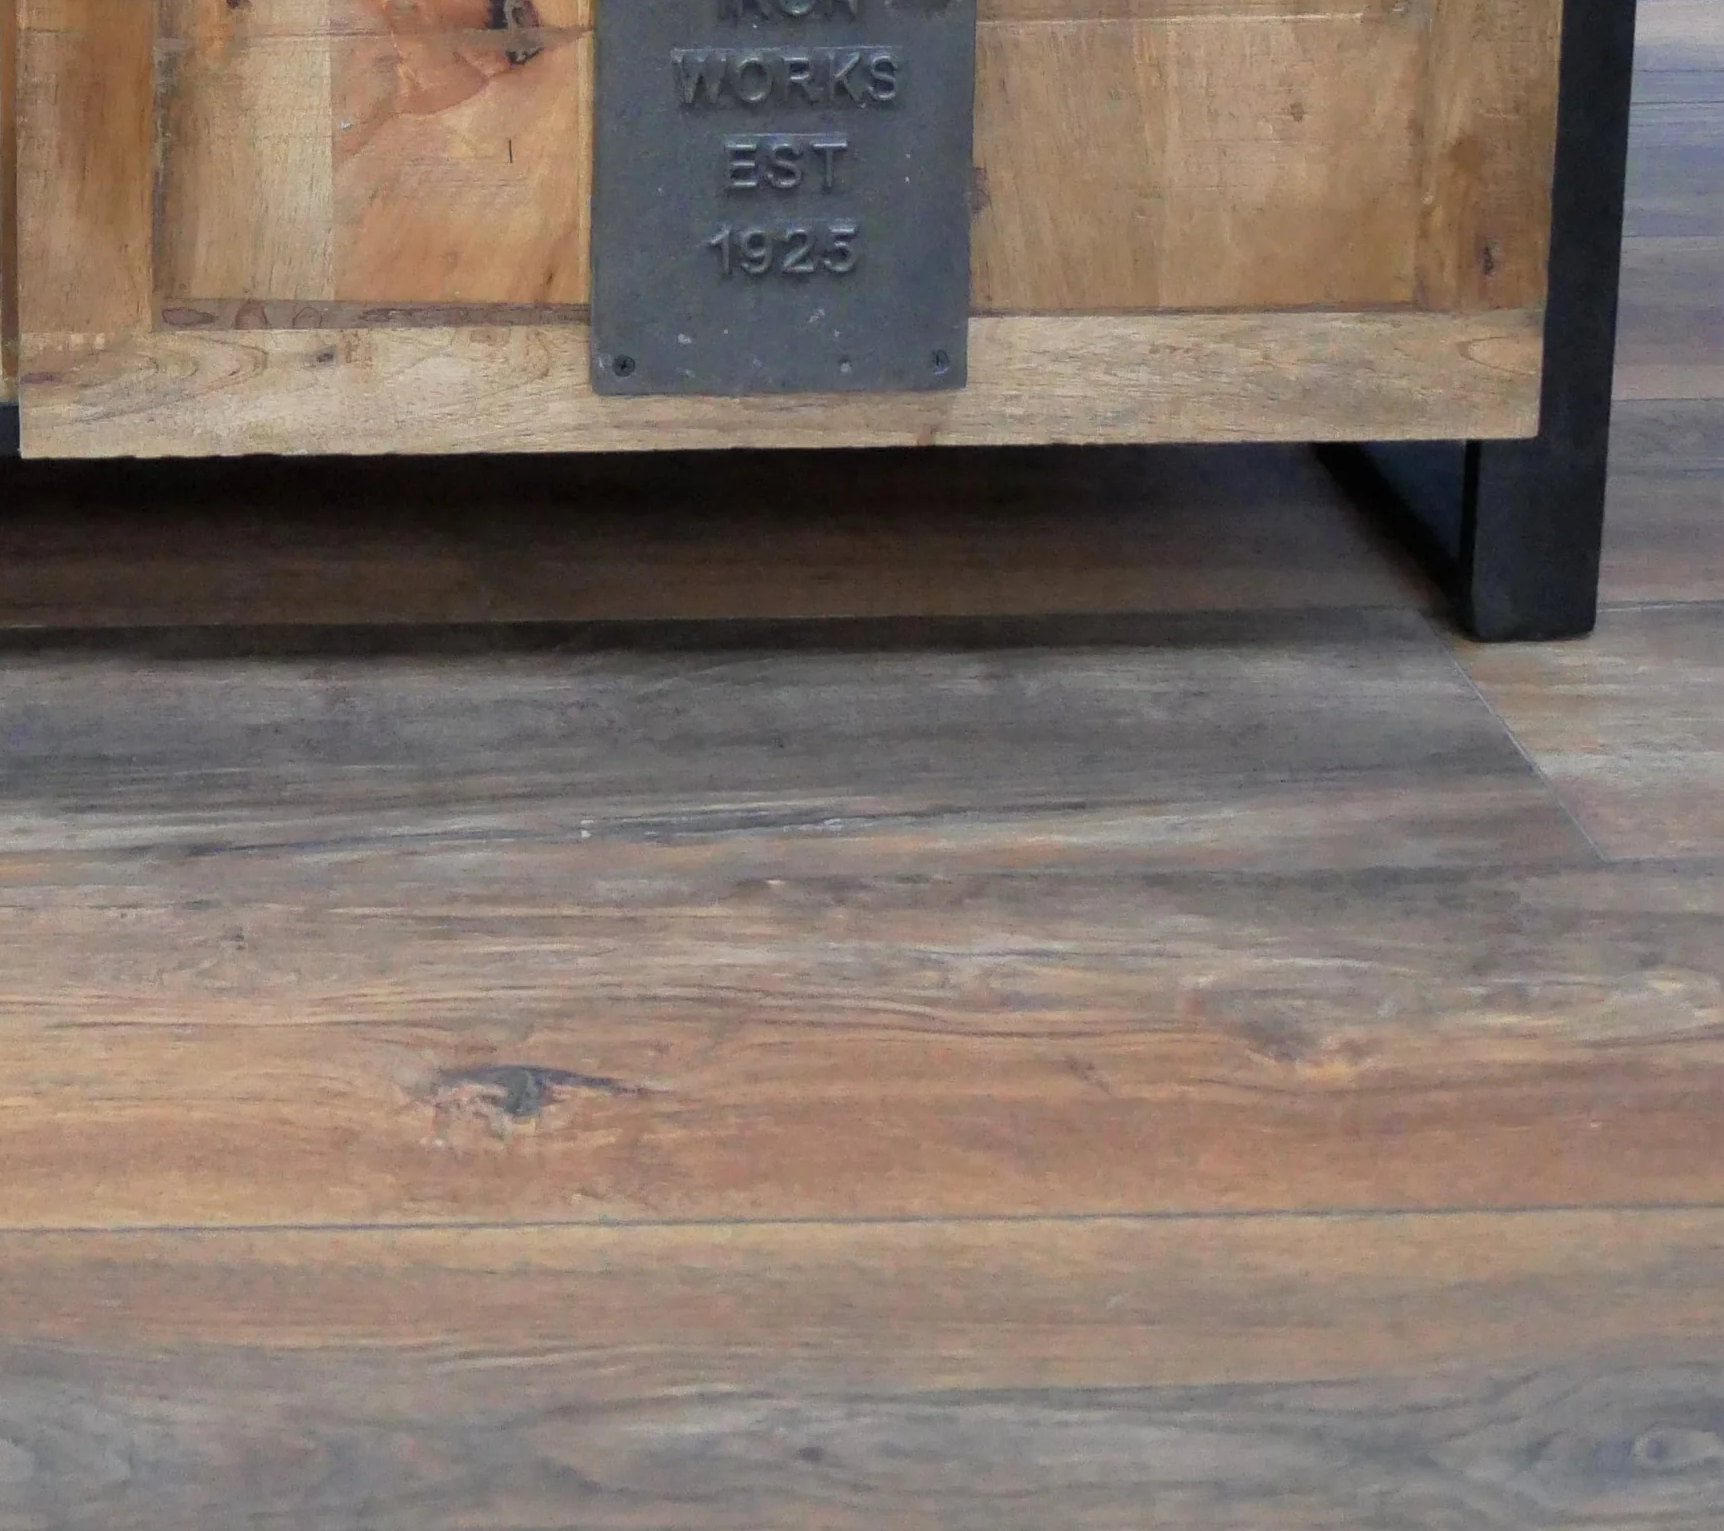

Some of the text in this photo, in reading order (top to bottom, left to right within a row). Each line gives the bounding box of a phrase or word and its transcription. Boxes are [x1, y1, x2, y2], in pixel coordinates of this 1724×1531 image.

[673, 49, 901, 109] WORKS
[722, 139, 850, 195] EST
[707, 223, 860, 278] 1925
